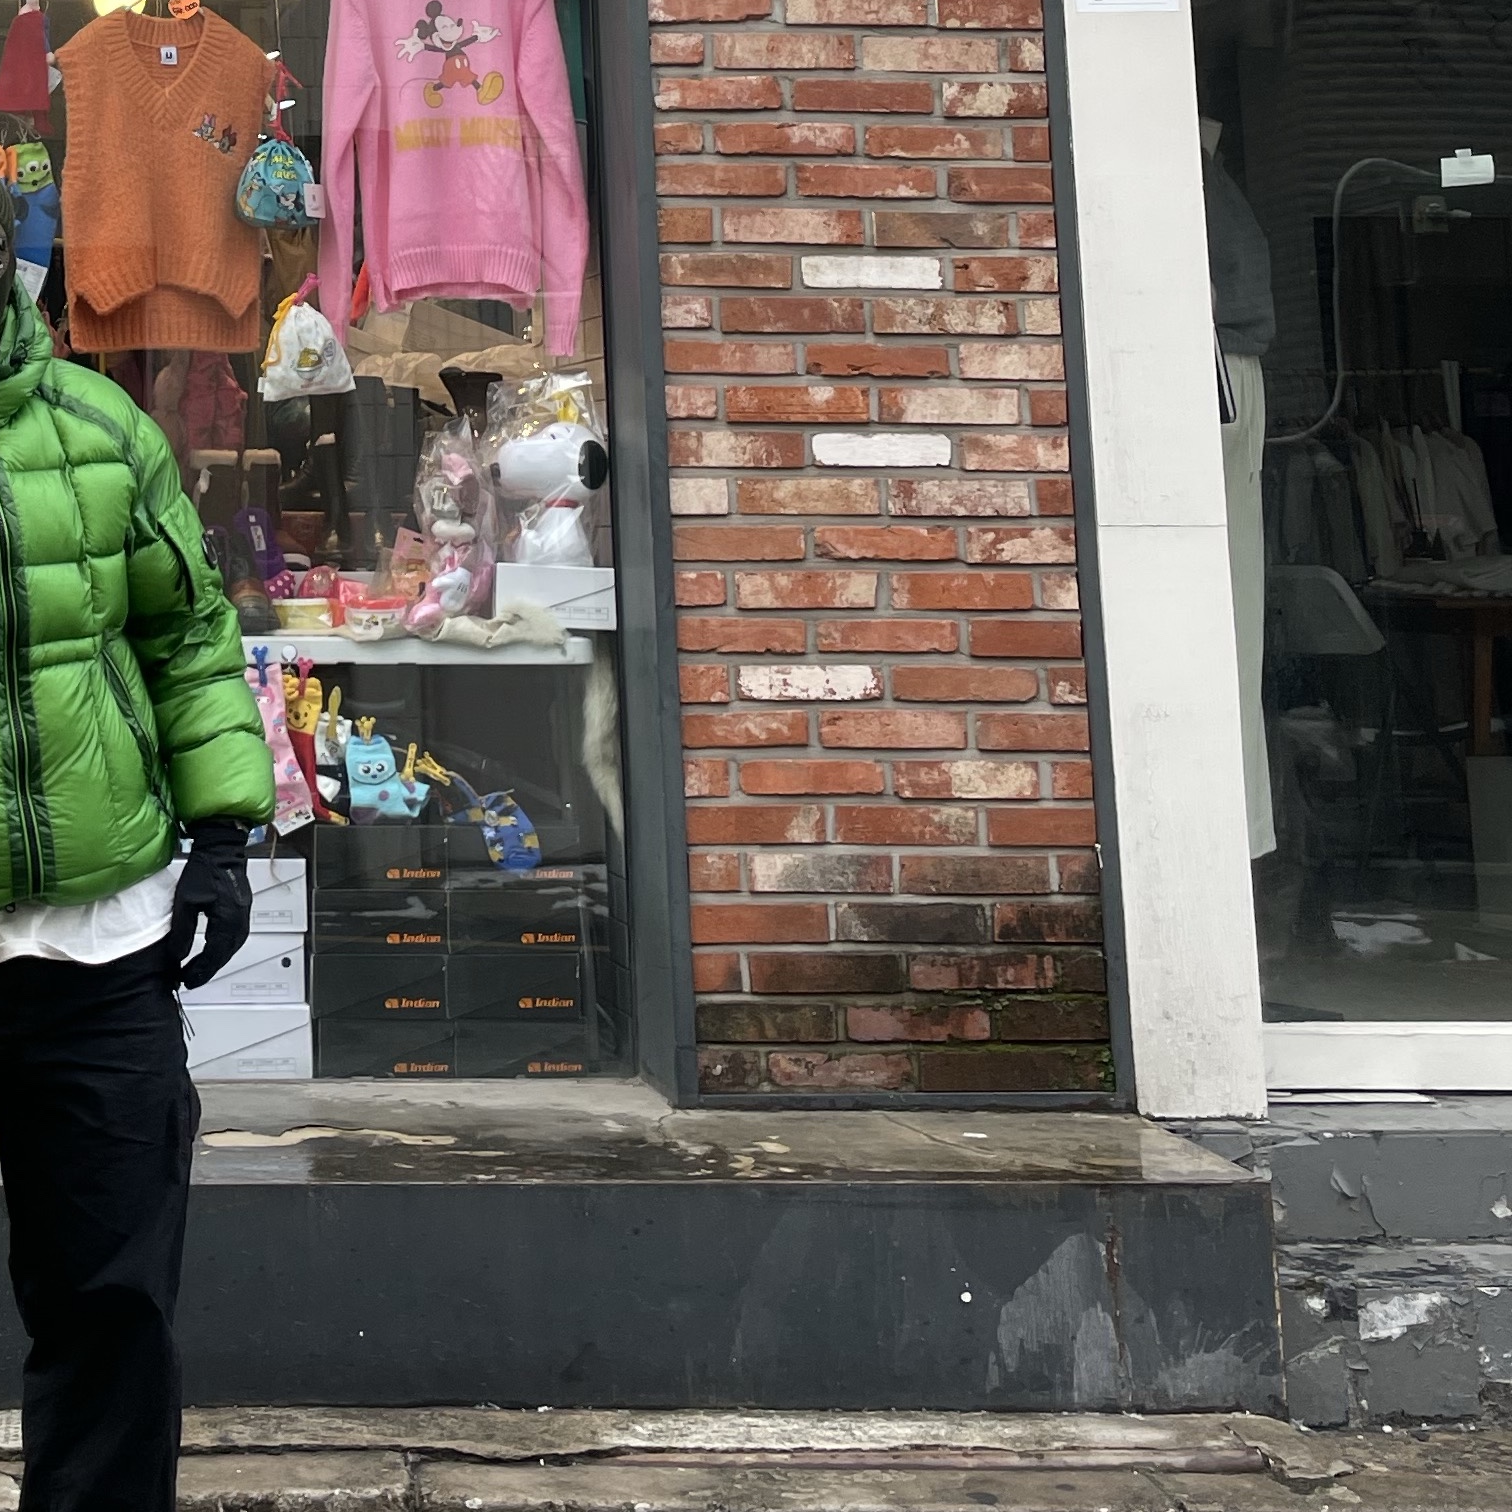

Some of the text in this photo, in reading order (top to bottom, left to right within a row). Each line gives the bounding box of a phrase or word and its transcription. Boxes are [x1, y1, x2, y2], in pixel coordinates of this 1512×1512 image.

[403, 868, 441, 879] Indian
[403, 933, 441, 944] Indian
[537, 932, 575, 943] Indian
[400, 997, 440, 1009] Indian
[535, 997, 574, 1008] Indian
[409, 1062, 449, 1073] Indian
[544, 1062, 582, 1072] Indian
